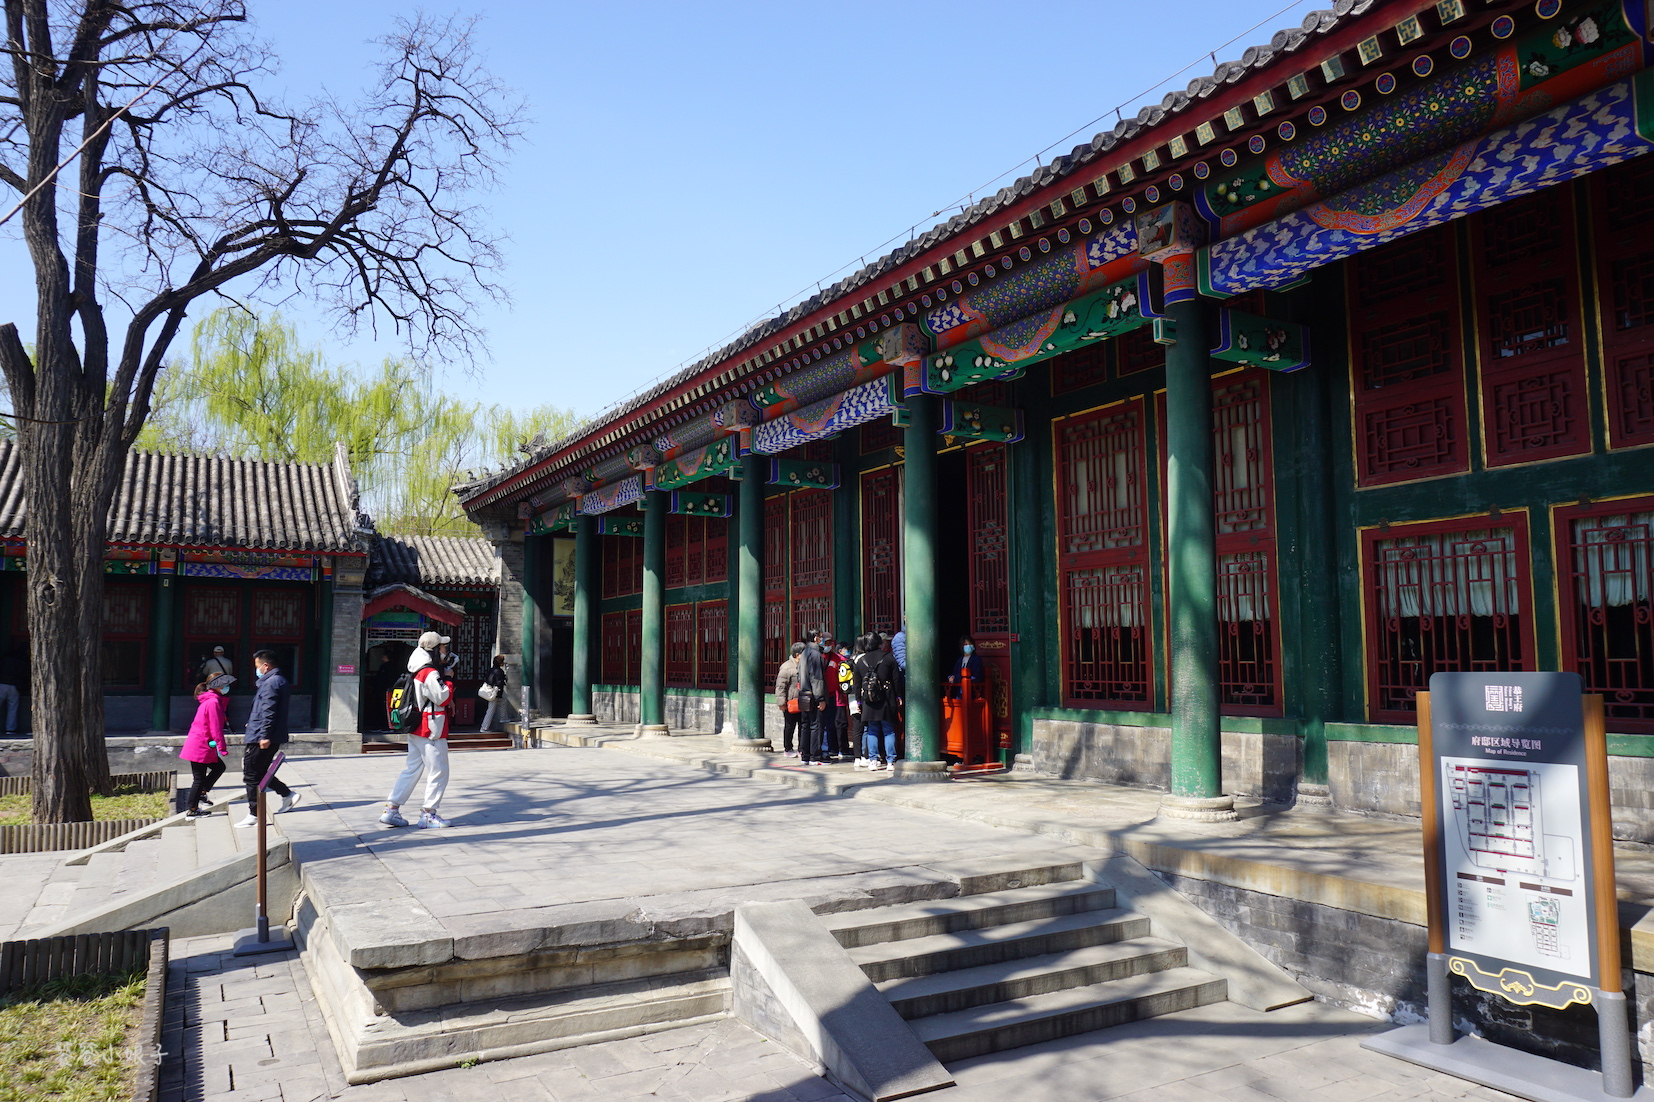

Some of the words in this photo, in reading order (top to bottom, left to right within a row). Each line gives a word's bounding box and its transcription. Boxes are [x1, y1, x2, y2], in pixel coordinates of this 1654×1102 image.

[1513, 685, 1523, 712] 恭王府
[1471, 736, 1541, 750] 府邸区域导览图
